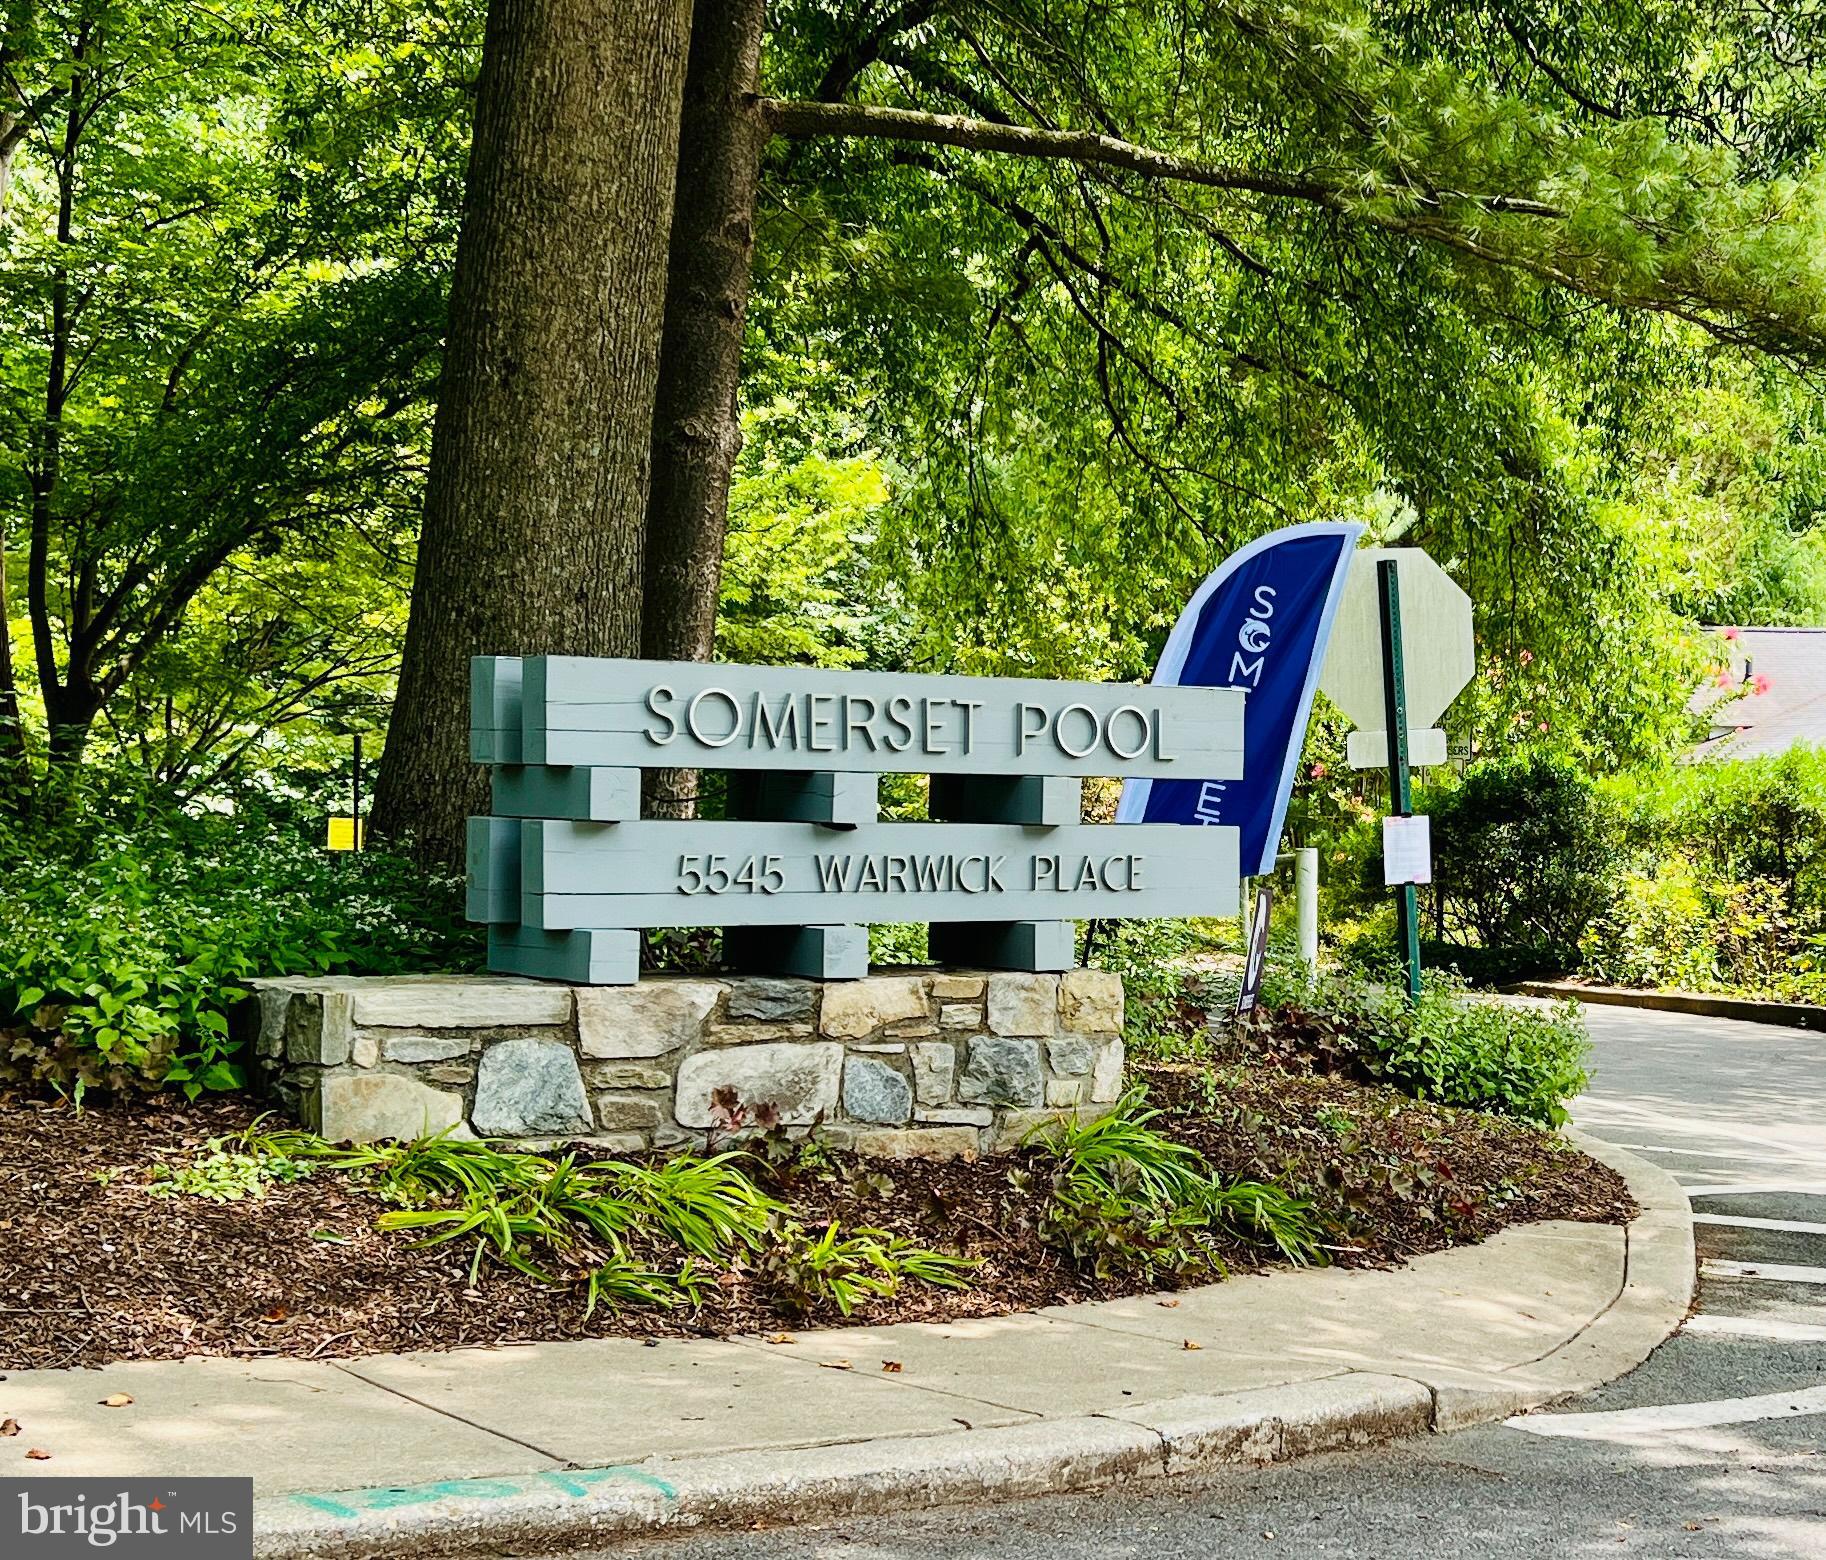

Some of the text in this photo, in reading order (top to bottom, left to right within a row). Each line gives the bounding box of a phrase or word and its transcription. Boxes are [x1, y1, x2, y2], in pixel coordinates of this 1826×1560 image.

[643, 684, 1179, 762] SOMERSET POOL
[677, 854, 1146, 895] 5545 WARWICK PLACE
